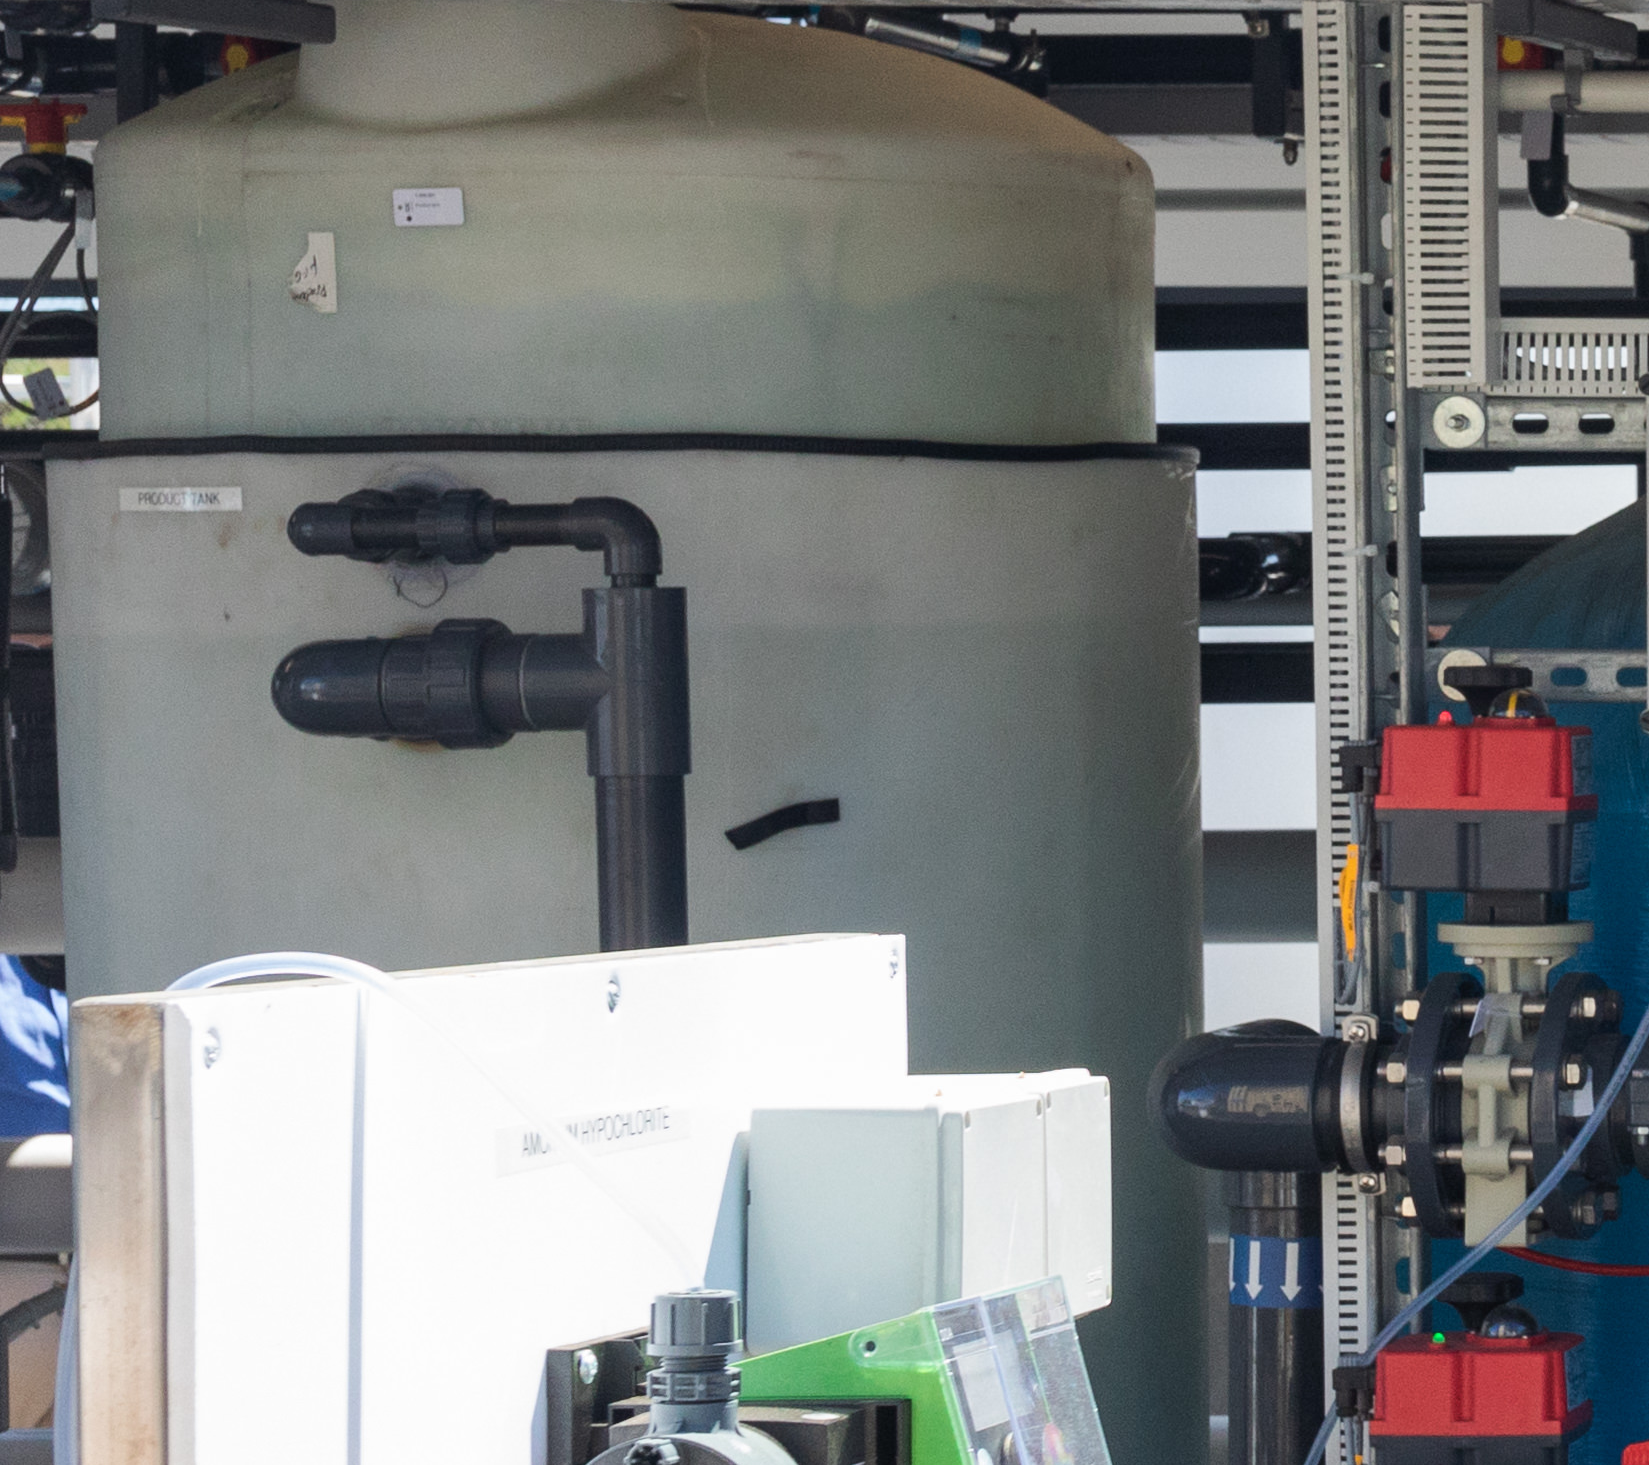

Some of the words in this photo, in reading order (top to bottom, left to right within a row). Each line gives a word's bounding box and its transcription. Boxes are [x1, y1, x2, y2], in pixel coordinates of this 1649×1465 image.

[138, 491, 187, 506] PRODUCT
[189, 491, 221, 505] TANK
[580, 1106, 671, 1144] HYPOCHLORITE
